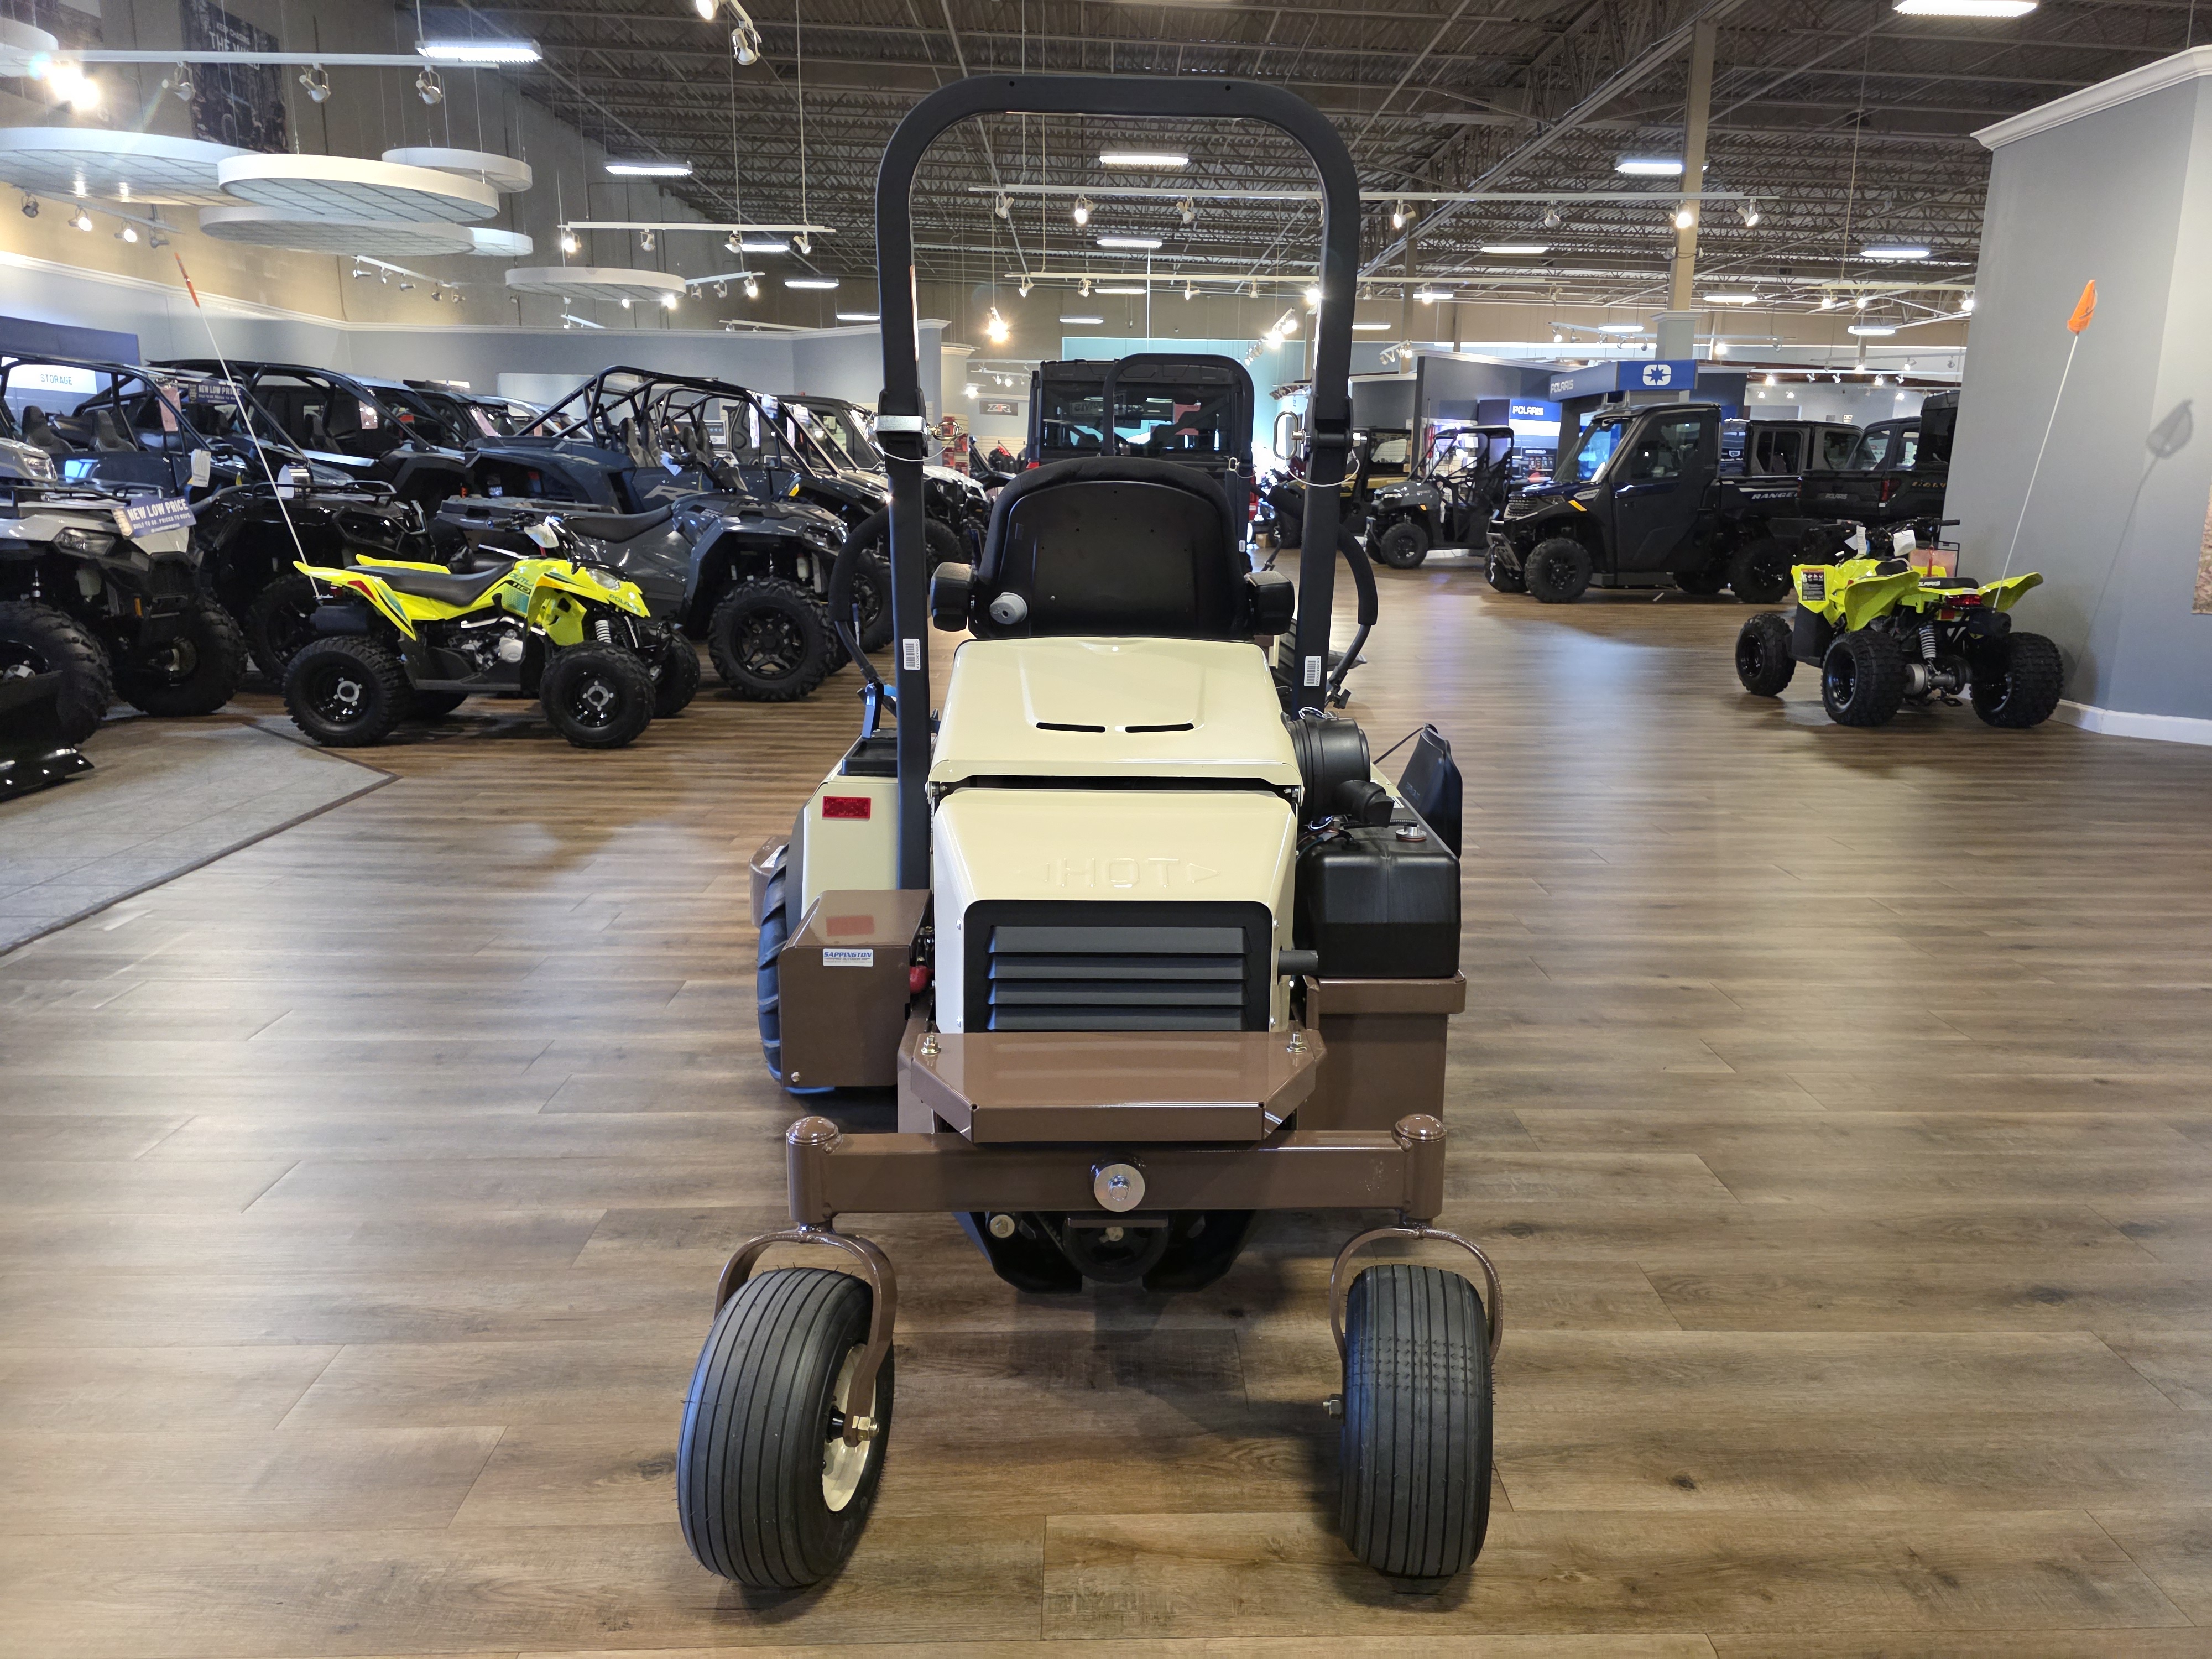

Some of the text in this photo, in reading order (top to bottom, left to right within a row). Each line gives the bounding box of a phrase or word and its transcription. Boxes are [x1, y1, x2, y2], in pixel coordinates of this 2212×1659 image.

[40, 374, 72, 385] STORAGE
[199, 384, 208, 393] NEW
[210, 385, 221, 394] LOW
[222, 387, 241, 396] PRIE
[1550, 379, 1574, 394] POLARIS
[1512, 405, 1544, 416] POLARIS
[127, 498, 189, 521] NEW LOW PRICE
[512, 582, 530, 593] 110
[608, 593, 641, 614] POLARIS
[1055, 857, 1180, 889] HOT
